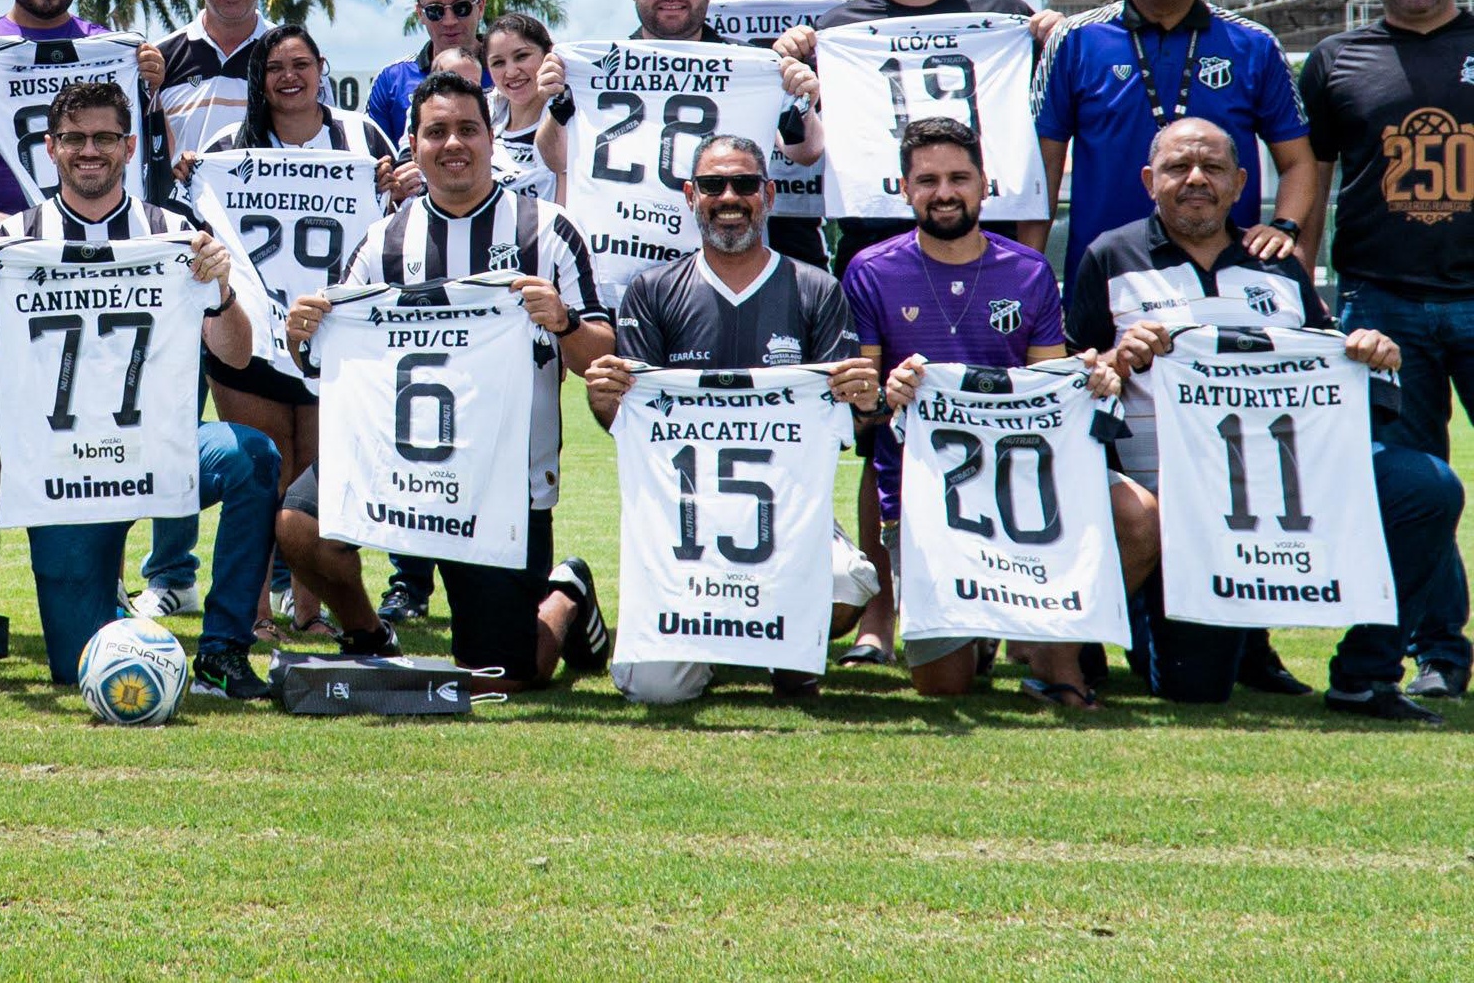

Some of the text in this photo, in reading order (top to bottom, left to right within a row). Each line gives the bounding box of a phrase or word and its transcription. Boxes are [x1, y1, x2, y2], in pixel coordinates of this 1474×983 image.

[890, 31, 958, 52] ICÓ/CE
[625, 49, 733, 72] brisanet
[591, 74, 729, 92] CUIABA/MT
[592, 92, 719, 192] 28
[258, 158, 354, 181] brisanet
[772, 150, 794, 166] mg
[1383, 134, 1474, 202] 250
[776, 175, 822, 194] med
[227, 192, 356, 214] LIMOEIRO/CE
[633, 204, 682, 234] bmg
[240, 215, 343, 307] 29
[16, 285, 162, 313] CANINDÉ/CE
[388, 330, 469, 347] IPU/CE
[29, 312, 154, 431] 77
[395, 353, 456, 462] 6
[679, 387, 795, 407] brisanet
[1179, 384, 1341, 408] BATURITE/CE
[650, 422, 801, 443] ARACATI/CE
[86, 444, 125, 463] bmg
[45, 473, 154, 500] Unimed
[930, 428, 1063, 544] 20
[1216, 413, 1314, 532] 11
[409, 475, 459, 504] bmg
[672, 445, 775, 564] 15
[366, 502, 476, 538] Unimed
[998, 554, 1048, 584] bmg
[1256, 545, 1312, 573] bmg
[706, 577, 759, 607] bmg
[956, 578, 1082, 612] Unimed
[1213, 575, 1341, 603] Unimed
[658, 612, 784, 640] Unimed
[106, 642, 180, 675] PENALTY
